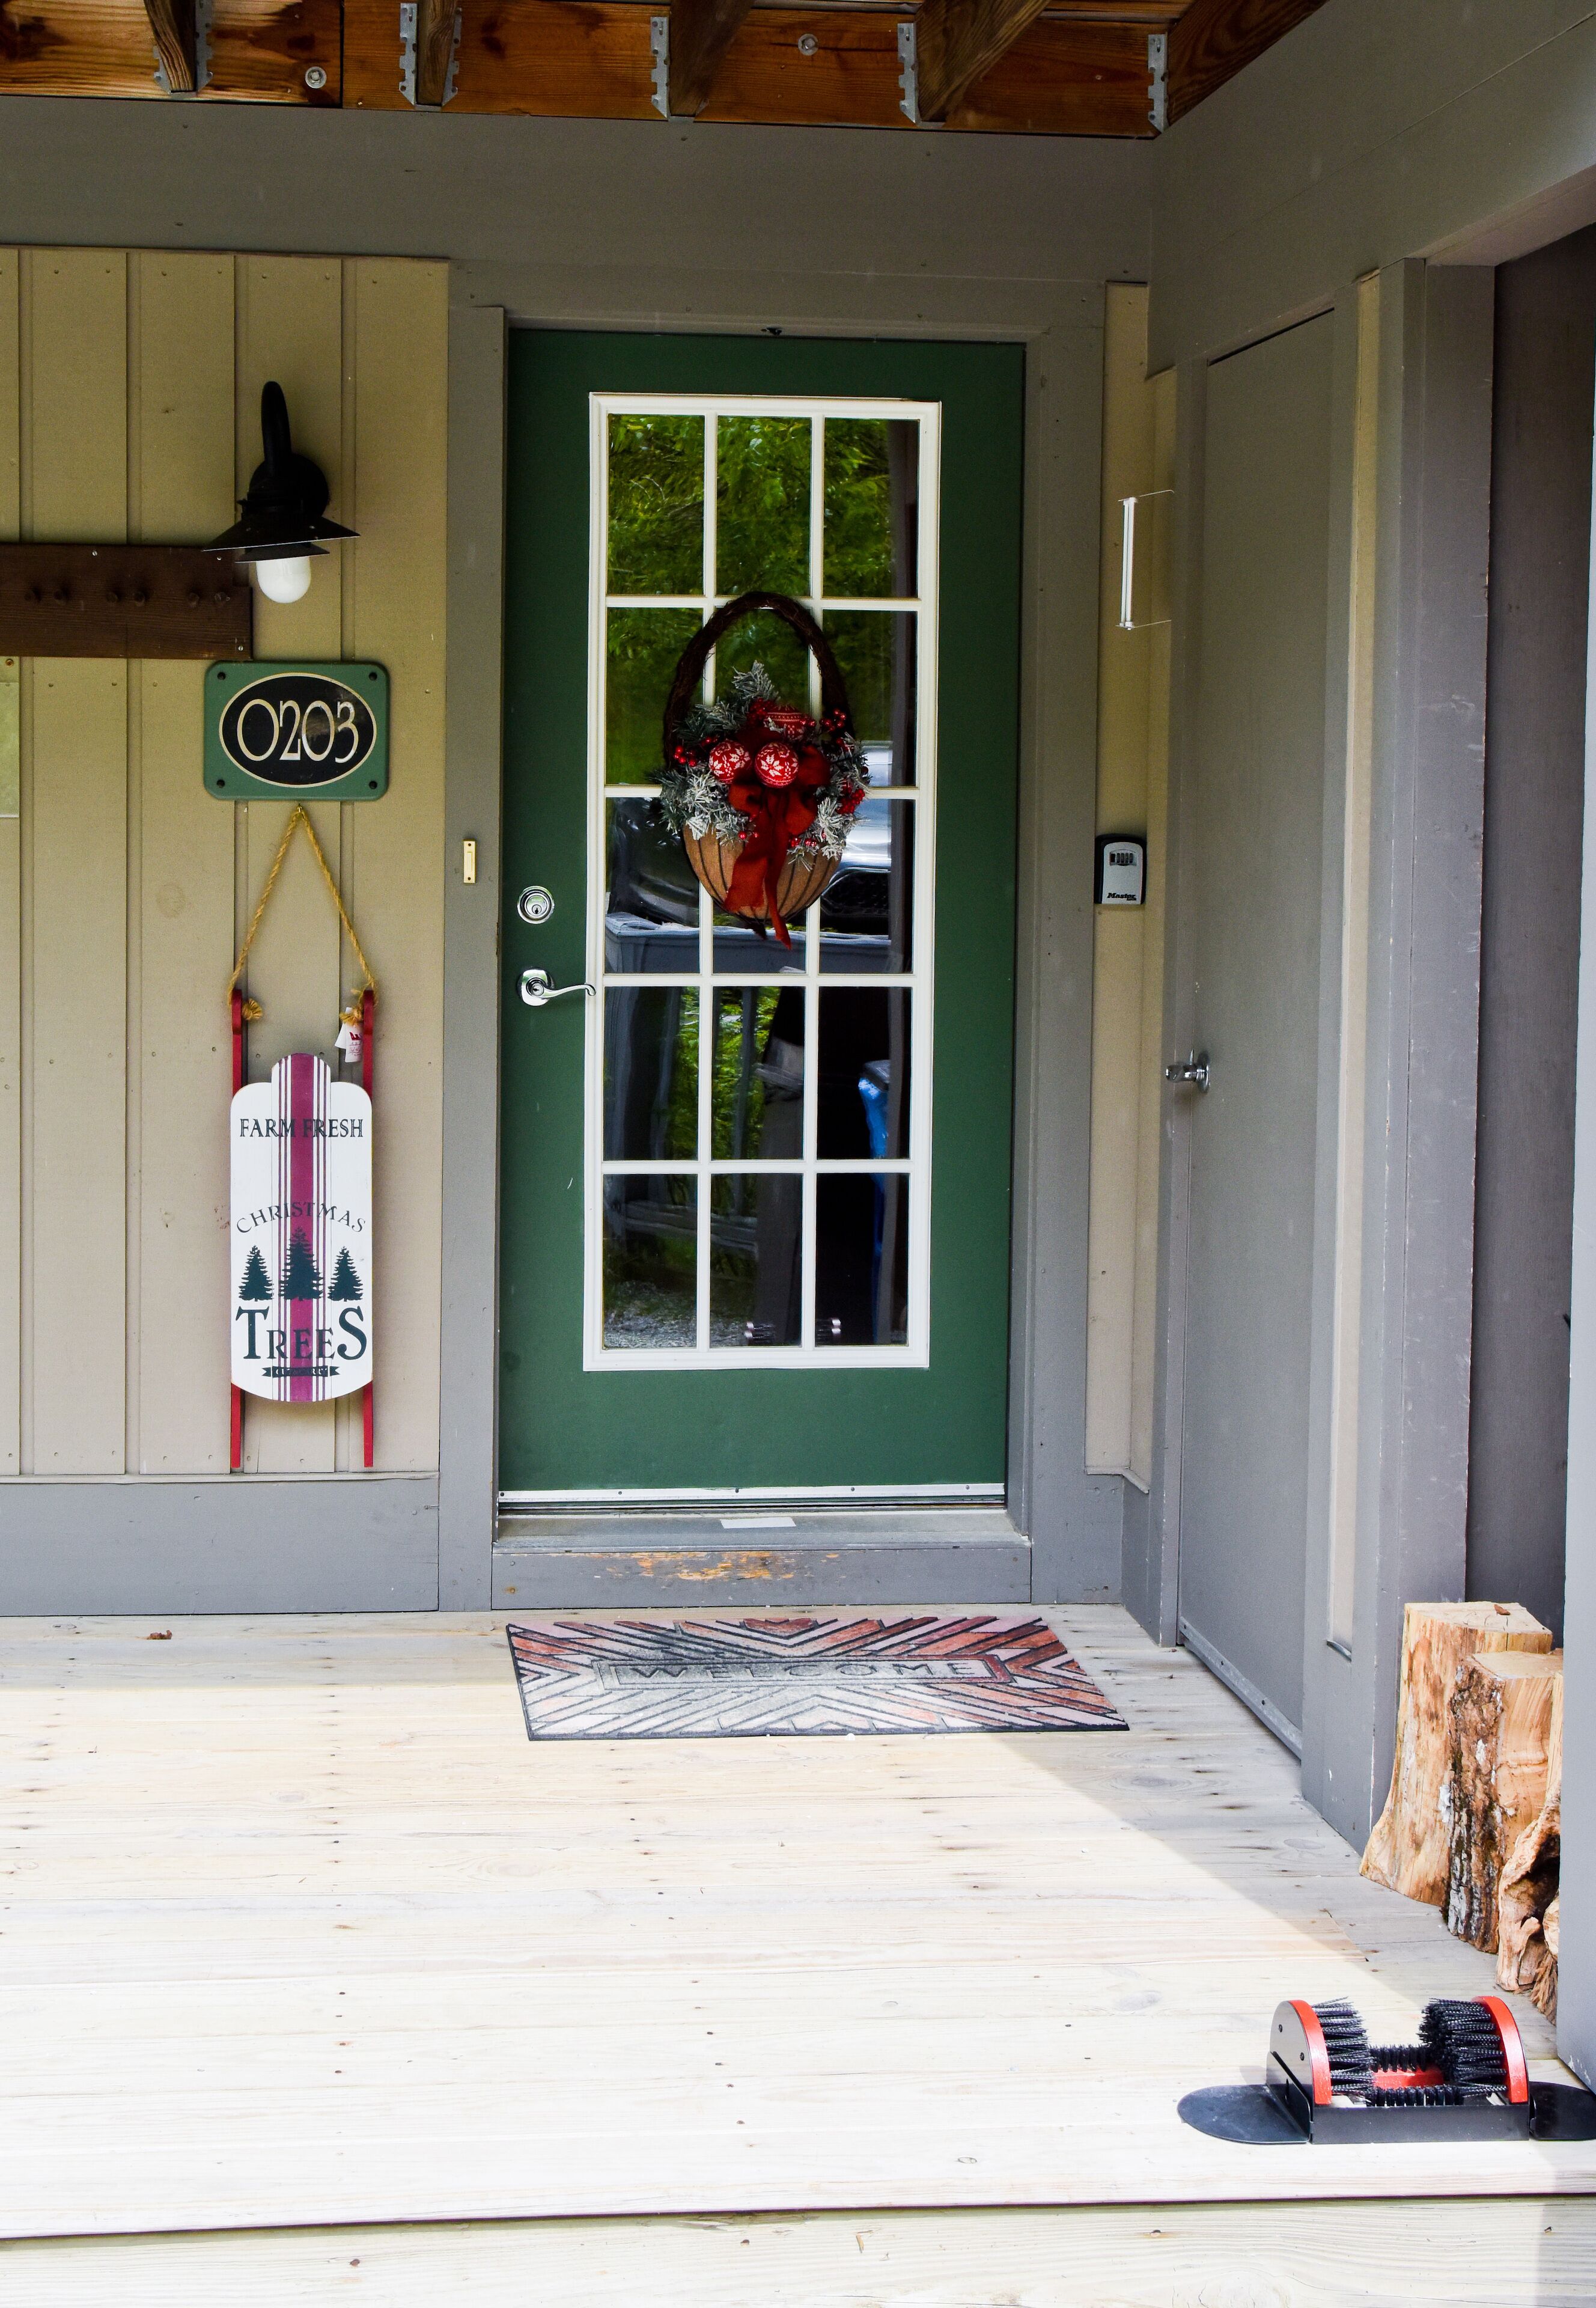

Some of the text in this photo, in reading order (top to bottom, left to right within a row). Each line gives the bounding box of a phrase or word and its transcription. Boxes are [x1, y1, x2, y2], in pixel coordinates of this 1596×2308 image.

[240, 1119, 364, 1137] FARM FRESH
[236, 1202, 366, 1233] CHRISTMAS
[630, 1662, 975, 1679] WELCOME
